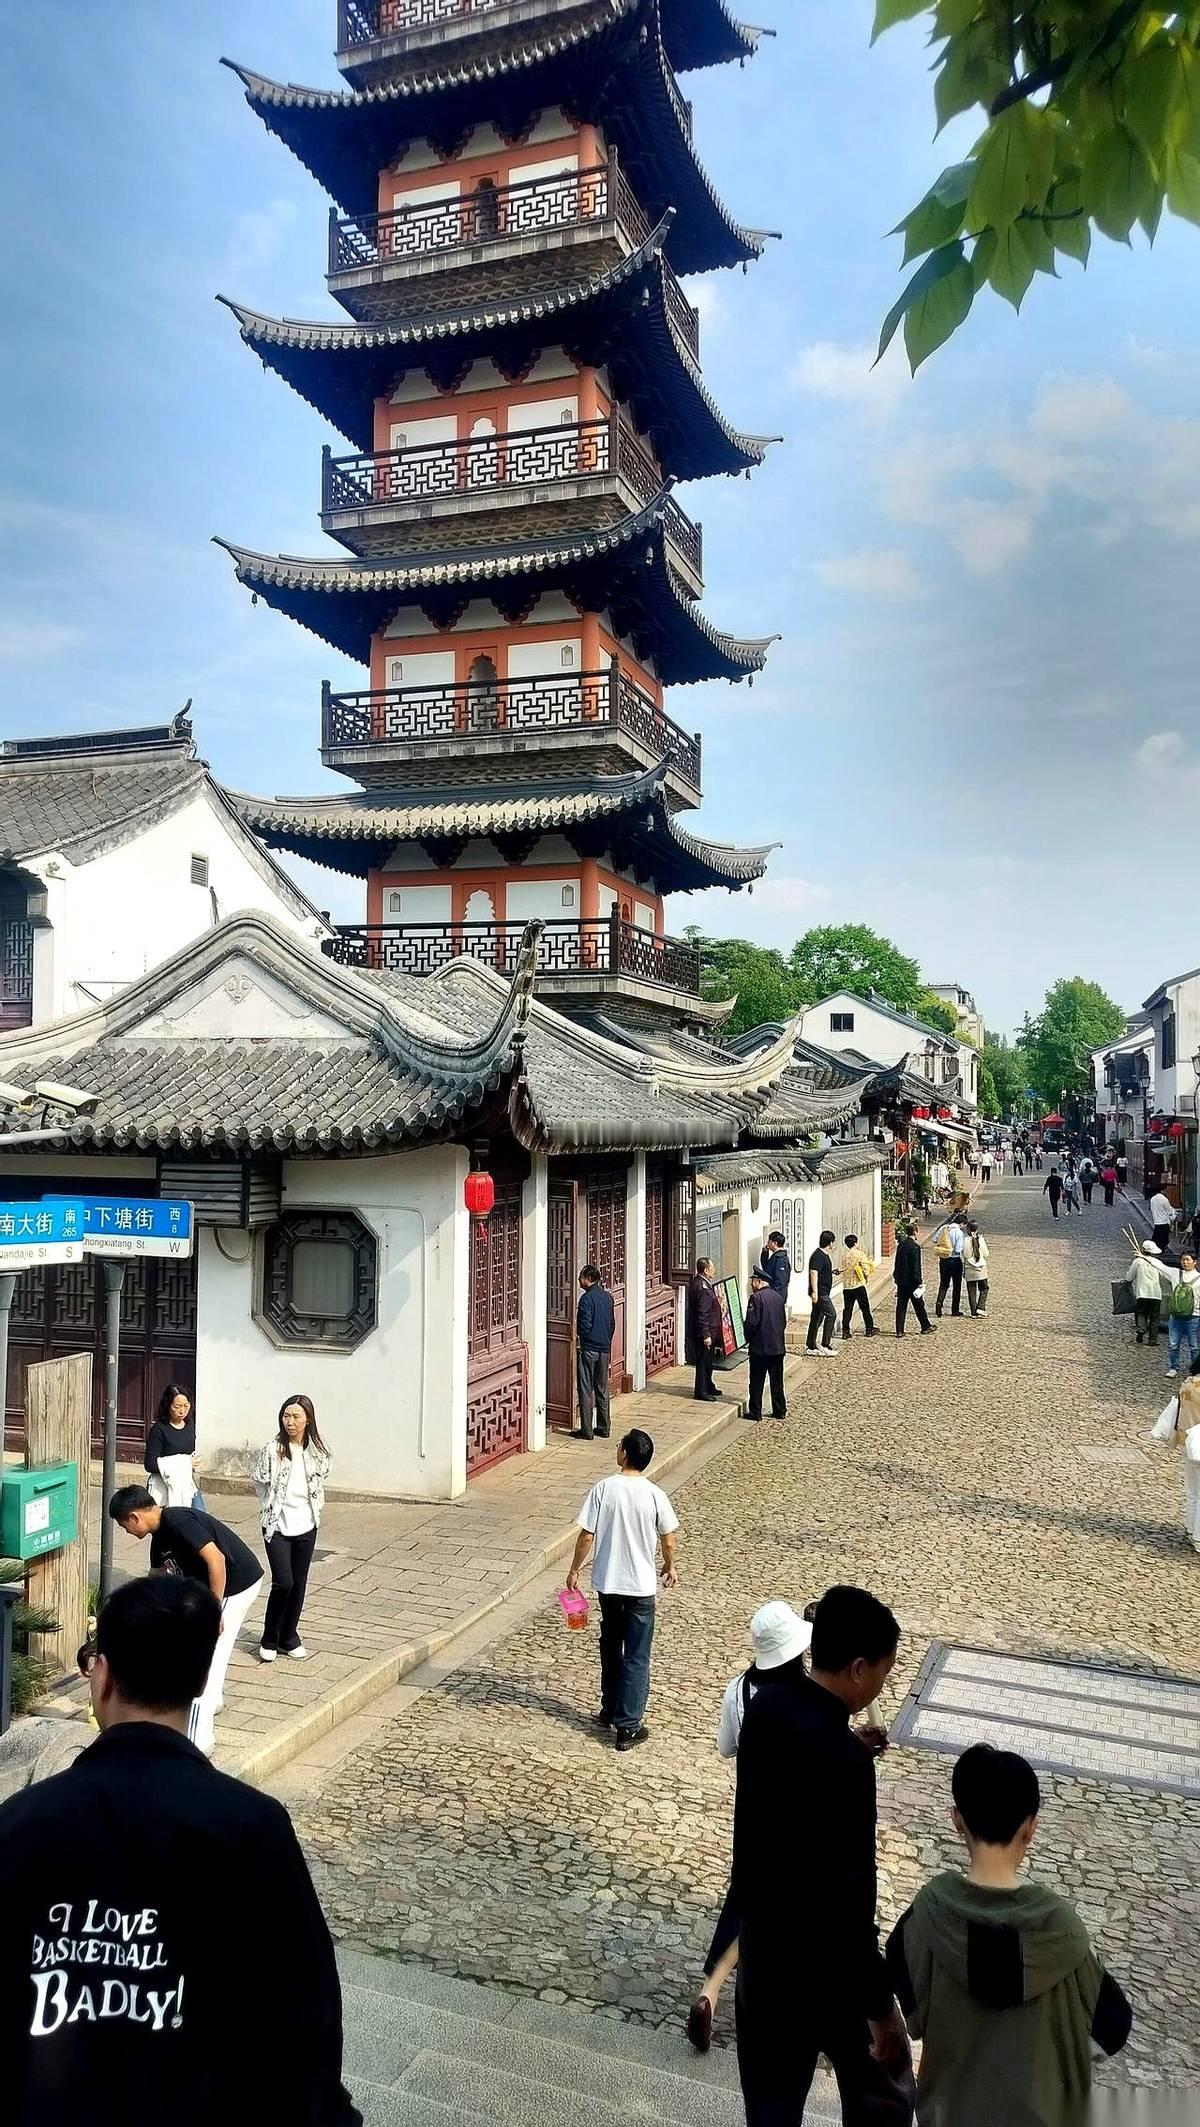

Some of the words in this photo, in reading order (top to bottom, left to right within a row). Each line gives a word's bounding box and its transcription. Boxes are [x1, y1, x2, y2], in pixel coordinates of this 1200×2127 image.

[65, 1208, 76, 1224] 南
[169, 1207, 181, 1221] 西
[0, 1213, 54, 1237] 南大街
[62, 1227, 77, 1237] 265
[171, 1224, 178, 1234] 8
[66, 1246, 73, 1258] S
[169, 1242, 181, 1253] W
[49, 1903, 73, 1933] I
[81, 1899, 159, 1942] LOVE
[31, 1933, 168, 1970] BASKETBALL
[30, 1969, 185, 2036] BADLY!
